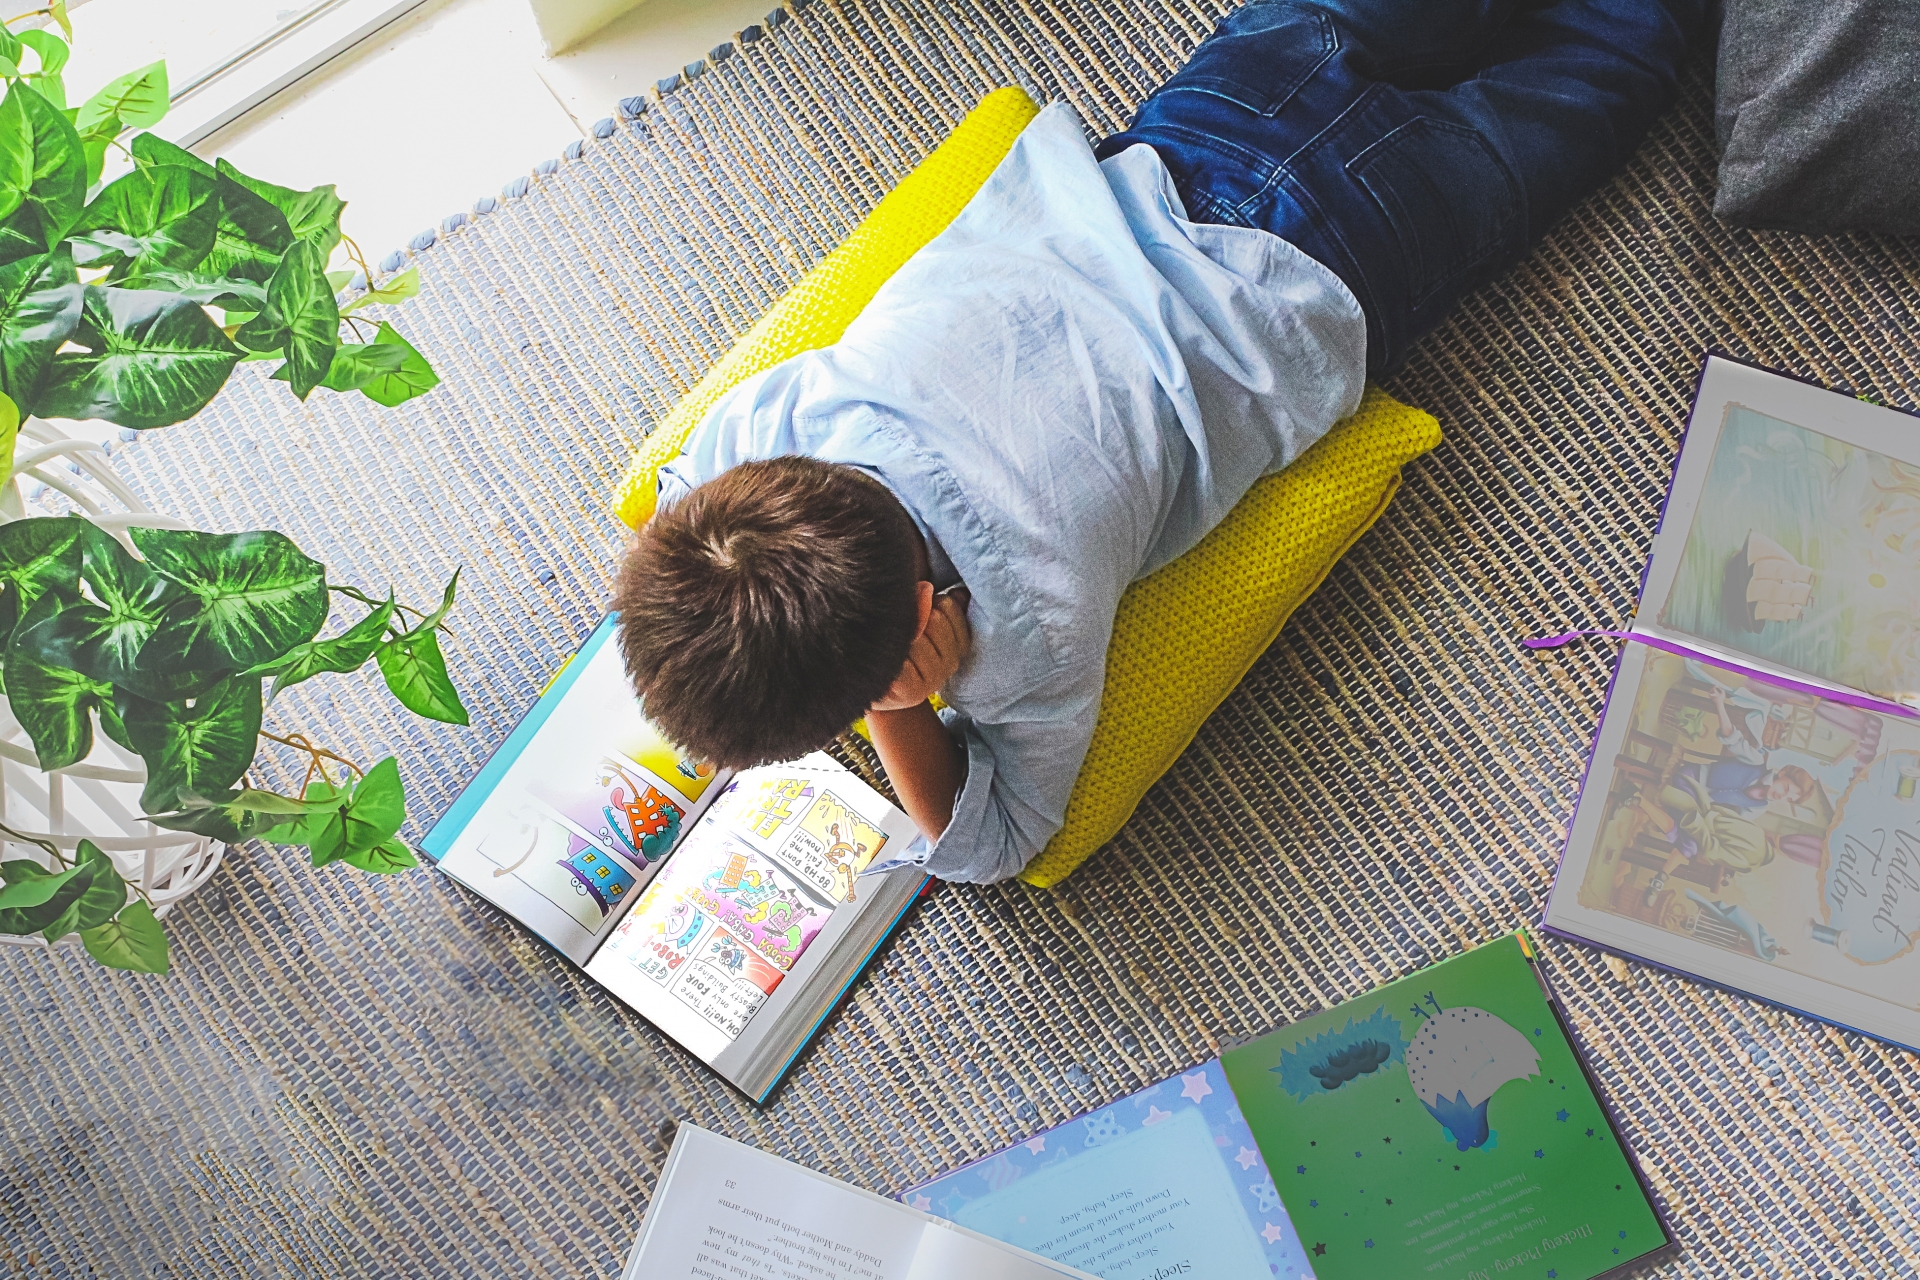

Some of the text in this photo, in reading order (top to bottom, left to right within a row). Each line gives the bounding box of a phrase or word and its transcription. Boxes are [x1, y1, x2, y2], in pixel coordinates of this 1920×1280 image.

[787, 840, 804, 855] me
[1830, 828, 1885, 912] Tailor
[1872, 828, 1920, 947] Valiant
[683, 973, 710, 997] FOUR
[679, 986, 701, 1009] There
[730, 1007, 749, 1022] are
[725, 1179, 737, 1189] 33
[1492, 1172, 1526, 1189] Hickety
[1144, 1188, 1171, 1203] Down
[1496, 1184, 1542, 1206] Sometimes
[1057, 1188, 1134, 1224] Sleep, baby, sleep.
[1125, 1200, 1144, 1213] falls
[1168, 1197, 1190, 1210] Your
[1443, 1199, 1459, 1211] my
[1478, 1202, 1497, 1214] nine
[1518, 1204, 1534, 1215] She
[1096, 1212, 1118, 1227] little
[1137, 1206, 1167, 1224] mother
[1423, 1208, 1445, 1222] black
[1461, 1211, 1477, 1224] and
[1498, 1209, 1517, 1222] lays
[1067, 1221, 1094, 1237] dream
[1107, 1222, 1136, 1236] shakes
[1419, 1218, 1461, 1239] sometimes
[1481, 1216, 1499, 1230] eggs
[1512, 1215, 1547, 1233] Hickety
[708, 1224, 726, 1239] look
[718, 1198, 882, 1268] Daddy and Mother both put their arms
[726, 1233, 738, 1244] he
[1054, 1233, 1068, 1243] for
[1092, 1233, 1107, 1244] the
[1468, 1226, 1481, 1237] for
[1541, 1223, 1593, 1251] Hickety
[702, 1239, 721, 1250] new
[1081, 1221, 1175, 1266] Your father guards the
[1464, 1243, 1479, 1256] my
[695, 1252, 709, 1262] all
[725, 1246, 738, 1257] my
[804, 1246, 821, 1260] big
[1131, 1245, 1158, 1259] Sleep,
[1443, 1251, 1466, 1265] black
[710, 1258, 728, 1269] was
[740, 1254, 761, 1267] that
[796, 1257, 824, 1274] asked.
[820, 1254, 836, 1266] his
[1106, 1257, 1132, 1271] baby,
[729, 1264, 747, 1280] that
[825, 1270, 836, 1280] he
[852, 1267, 872, 1277] me?
[1148, 1259, 1191, 1280] Sleep,
